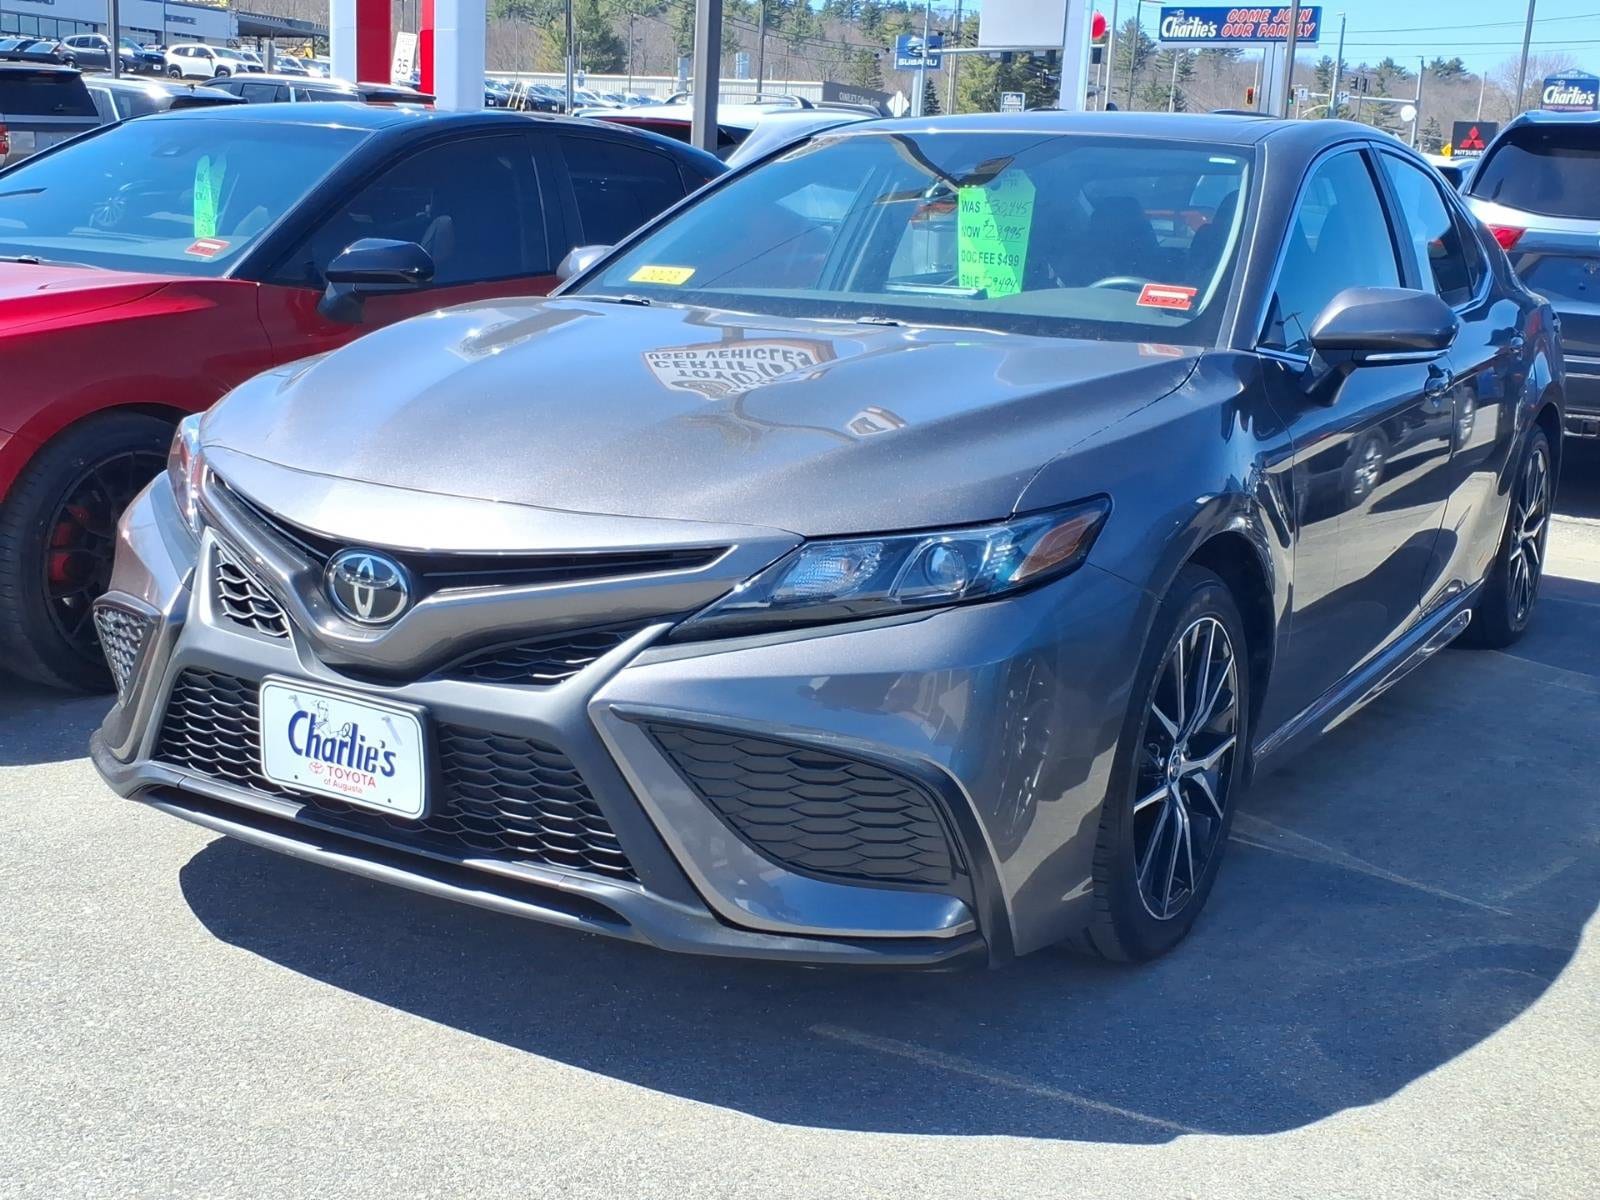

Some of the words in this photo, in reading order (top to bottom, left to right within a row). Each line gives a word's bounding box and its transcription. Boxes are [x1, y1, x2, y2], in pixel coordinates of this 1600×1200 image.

[1226, 8, 1271, 23] COME
[1273, 8, 1313, 23] JON
[1161, 15, 1217, 38] Charlie's
[1221, 23, 1254, 38] OUR
[1257, 23, 1317, 38] FAMLY
[395, 57, 409, 75] 35
[1542, 84, 1596, 105] Charlie's
[961, 200, 981, 214] WAS
[961, 225, 981, 239] NOW
[961, 249, 978, 263] DOC
[979, 251, 996, 265] FEE
[997, 253, 1020, 267] $499
[287, 710, 397, 778] Charlie's
[326, 765, 377, 788] TOYOTA
[332, 780, 364, 794] Augusta
